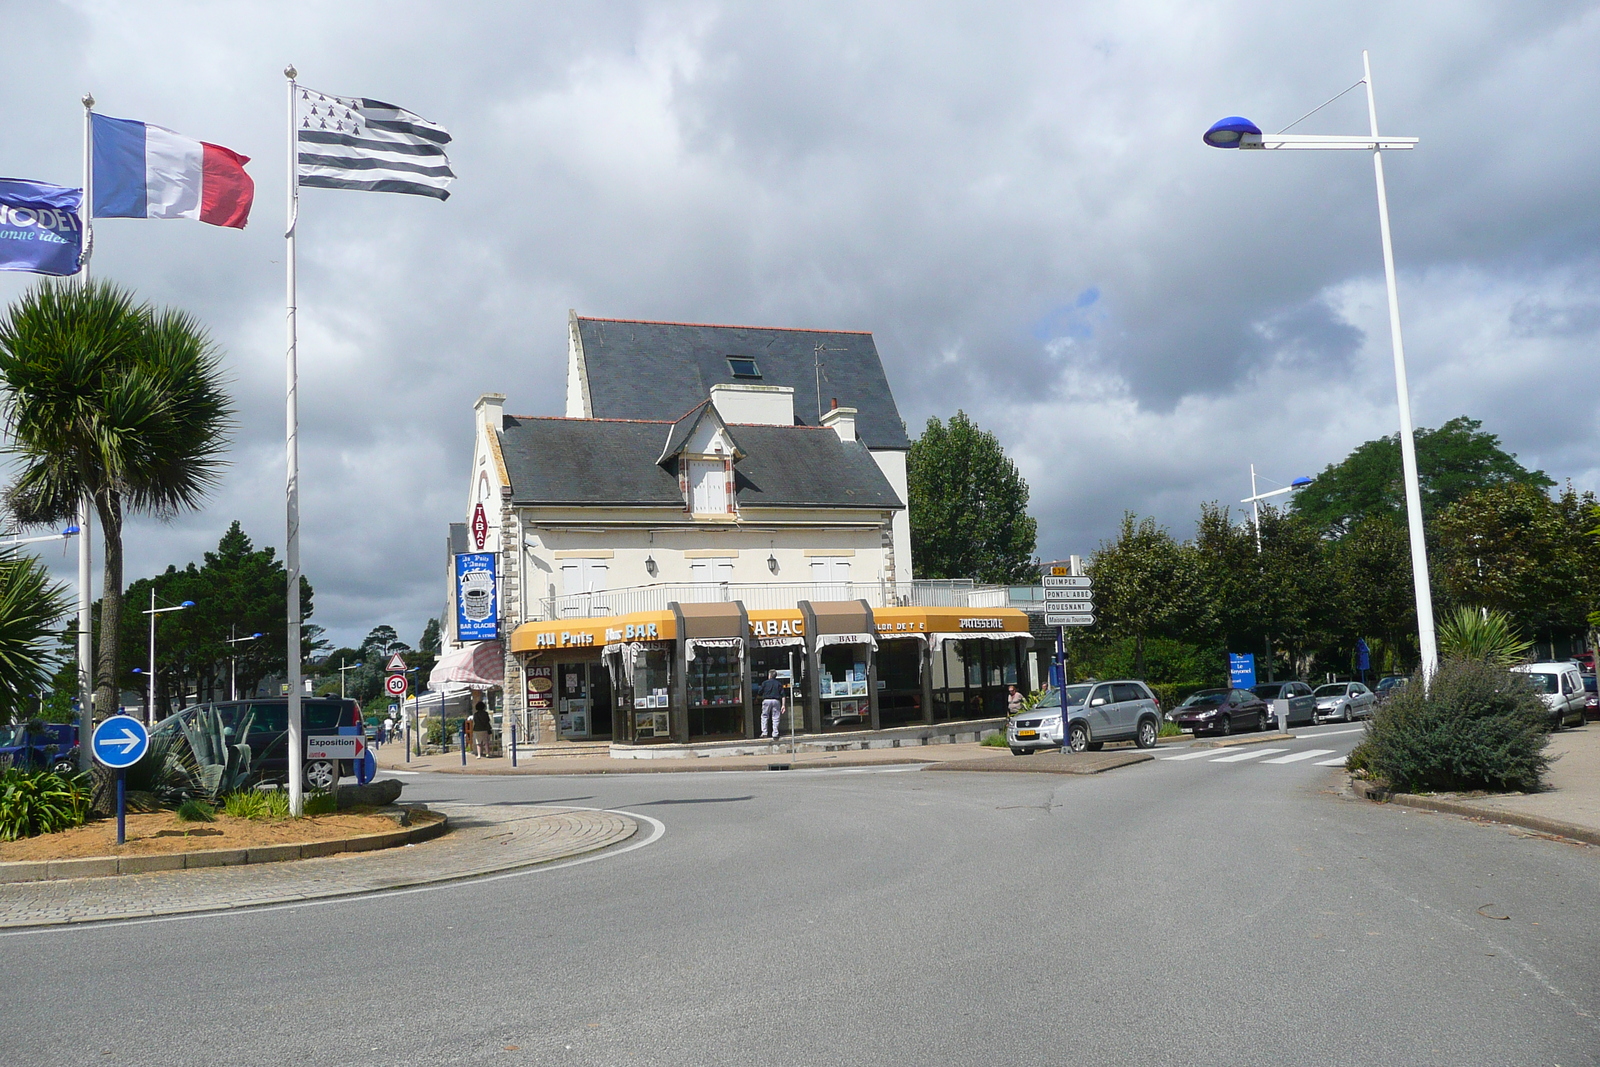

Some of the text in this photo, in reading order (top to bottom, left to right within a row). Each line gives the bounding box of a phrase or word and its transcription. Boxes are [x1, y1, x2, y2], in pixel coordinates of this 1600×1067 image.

[476, 506, 484, 547] TABAC
[625, 623, 658, 638] BAR
[536, 632, 556, 645] AU
[561, 631, 593, 644] Puits
[528, 667, 551, 677] BAR
[391, 681, 403, 689] 30
[310, 739, 354, 747] Exposition
